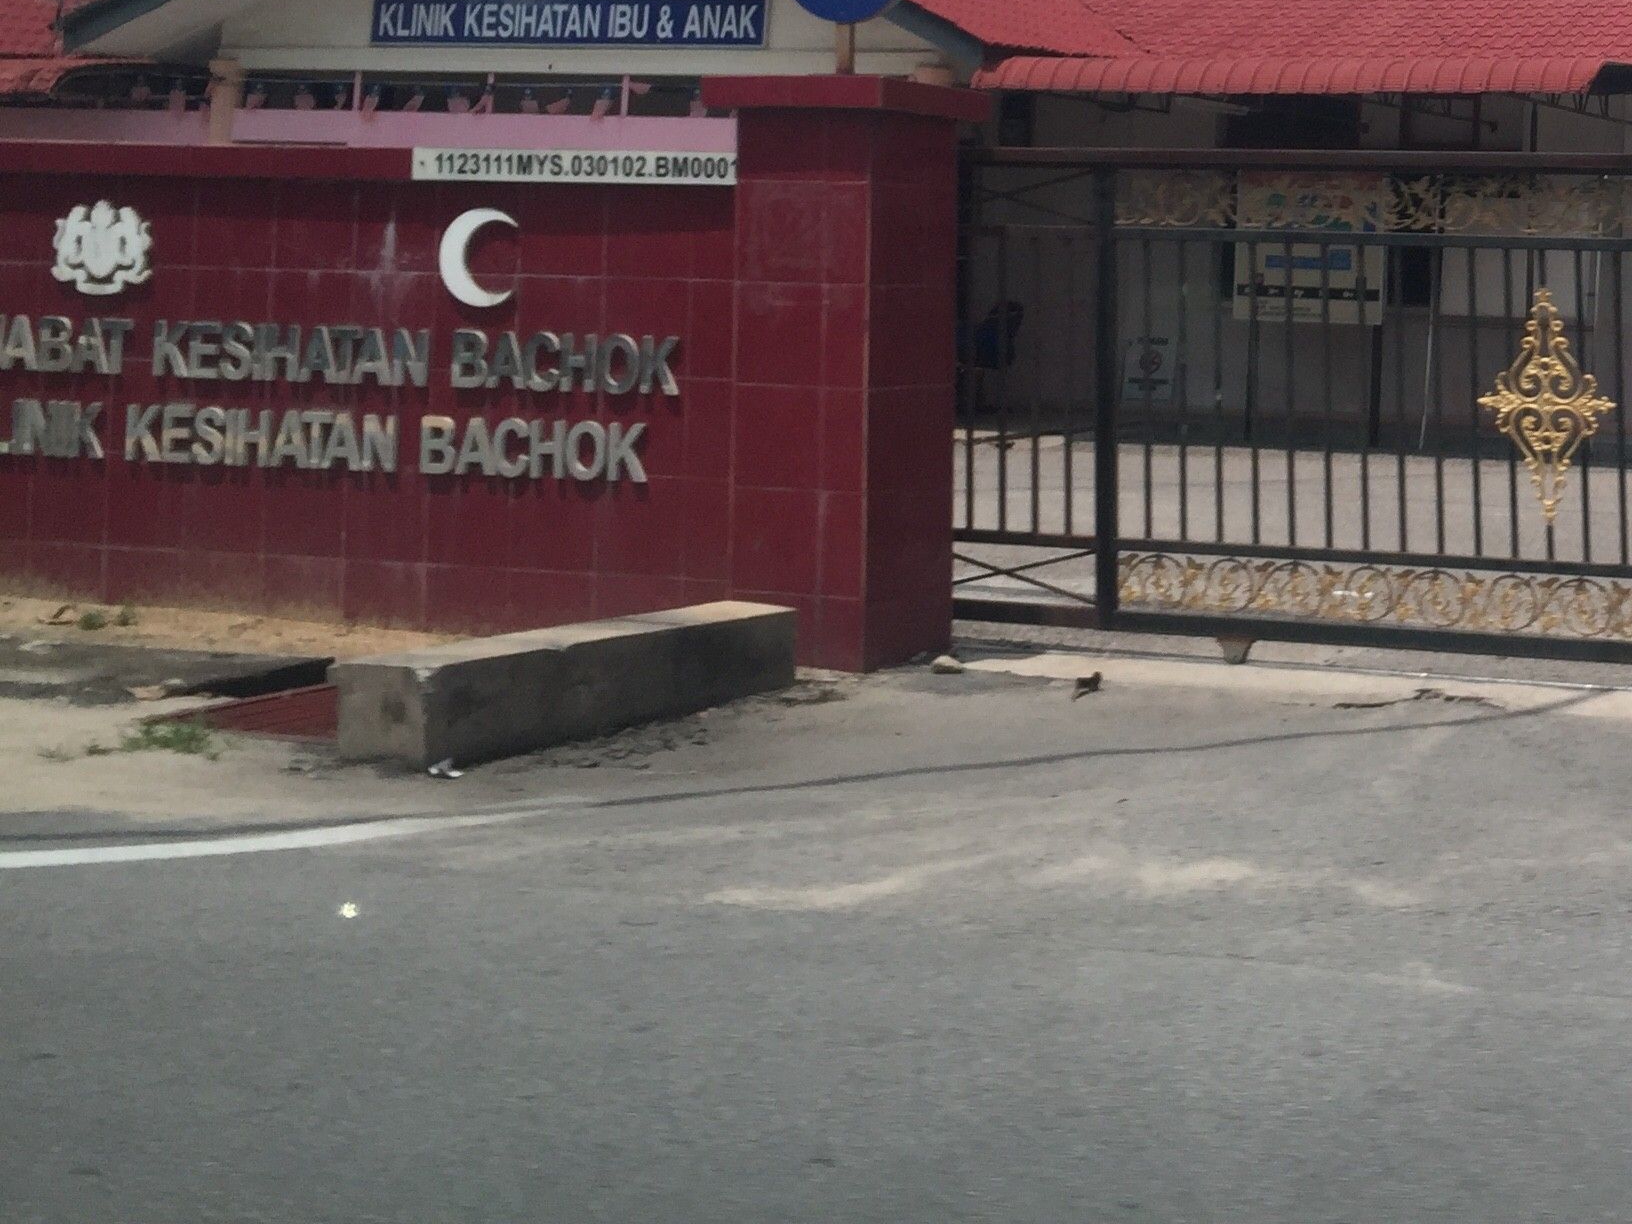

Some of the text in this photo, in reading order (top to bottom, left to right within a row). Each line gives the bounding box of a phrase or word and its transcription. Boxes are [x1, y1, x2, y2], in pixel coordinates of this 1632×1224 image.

[378, 3, 759, 40] KLINIK KESIHATAN IBU & ANAK
[153, 320, 430, 387] KESIHATAN
[450, 328, 680, 396] BACHOK
[125, 404, 398, 473] KESIHATAN
[418, 414, 648, 483] BACHOK
